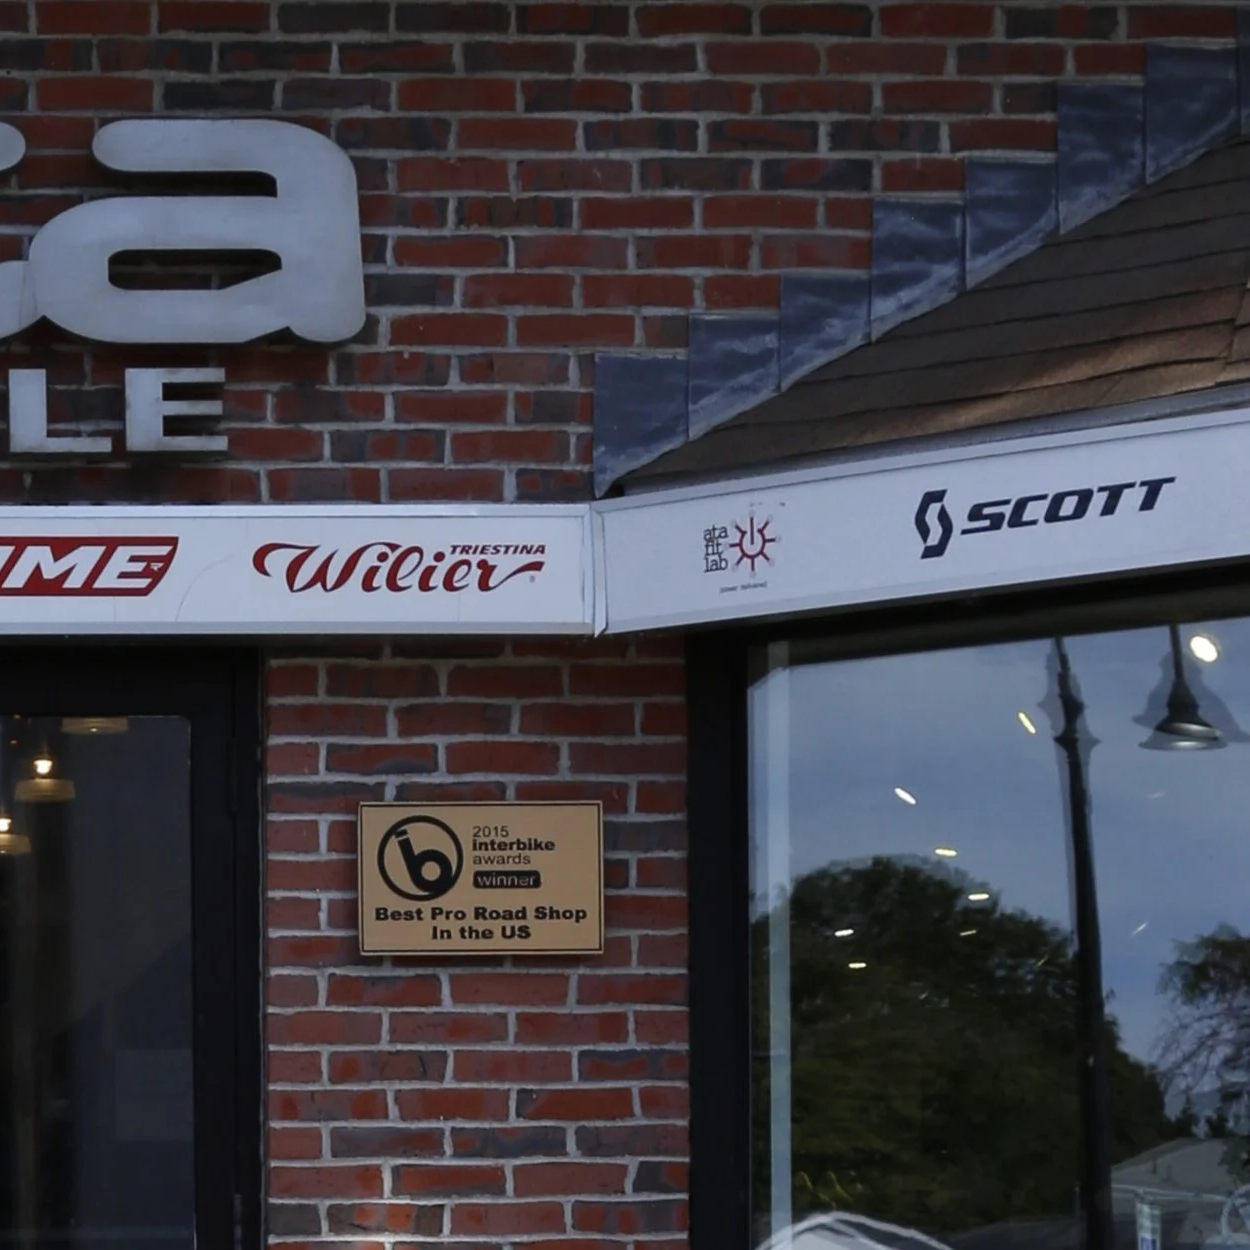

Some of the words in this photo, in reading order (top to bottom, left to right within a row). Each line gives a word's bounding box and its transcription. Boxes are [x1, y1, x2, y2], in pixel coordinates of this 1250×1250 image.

[960, 476, 1177, 536] SCOTT
[703, 524, 729, 541] ata
[450, 544, 547, 556] TRIESTINA
[252, 541, 547, 593] Wilier
[703, 555, 729, 573] lab
[472, 826, 510, 838] 2015
[472, 838, 556, 851] interbike
[472, 853, 532, 865] awards
[477, 873, 537, 887] winner
[375, 907, 424, 922] Best
[430, 907, 467, 922] Pro
[474, 906, 528, 921] Road
[534, 906, 588, 924] Shop
[431, 926, 452, 940] In
[459, 926, 494, 940] the
[501, 925, 532, 940] US
